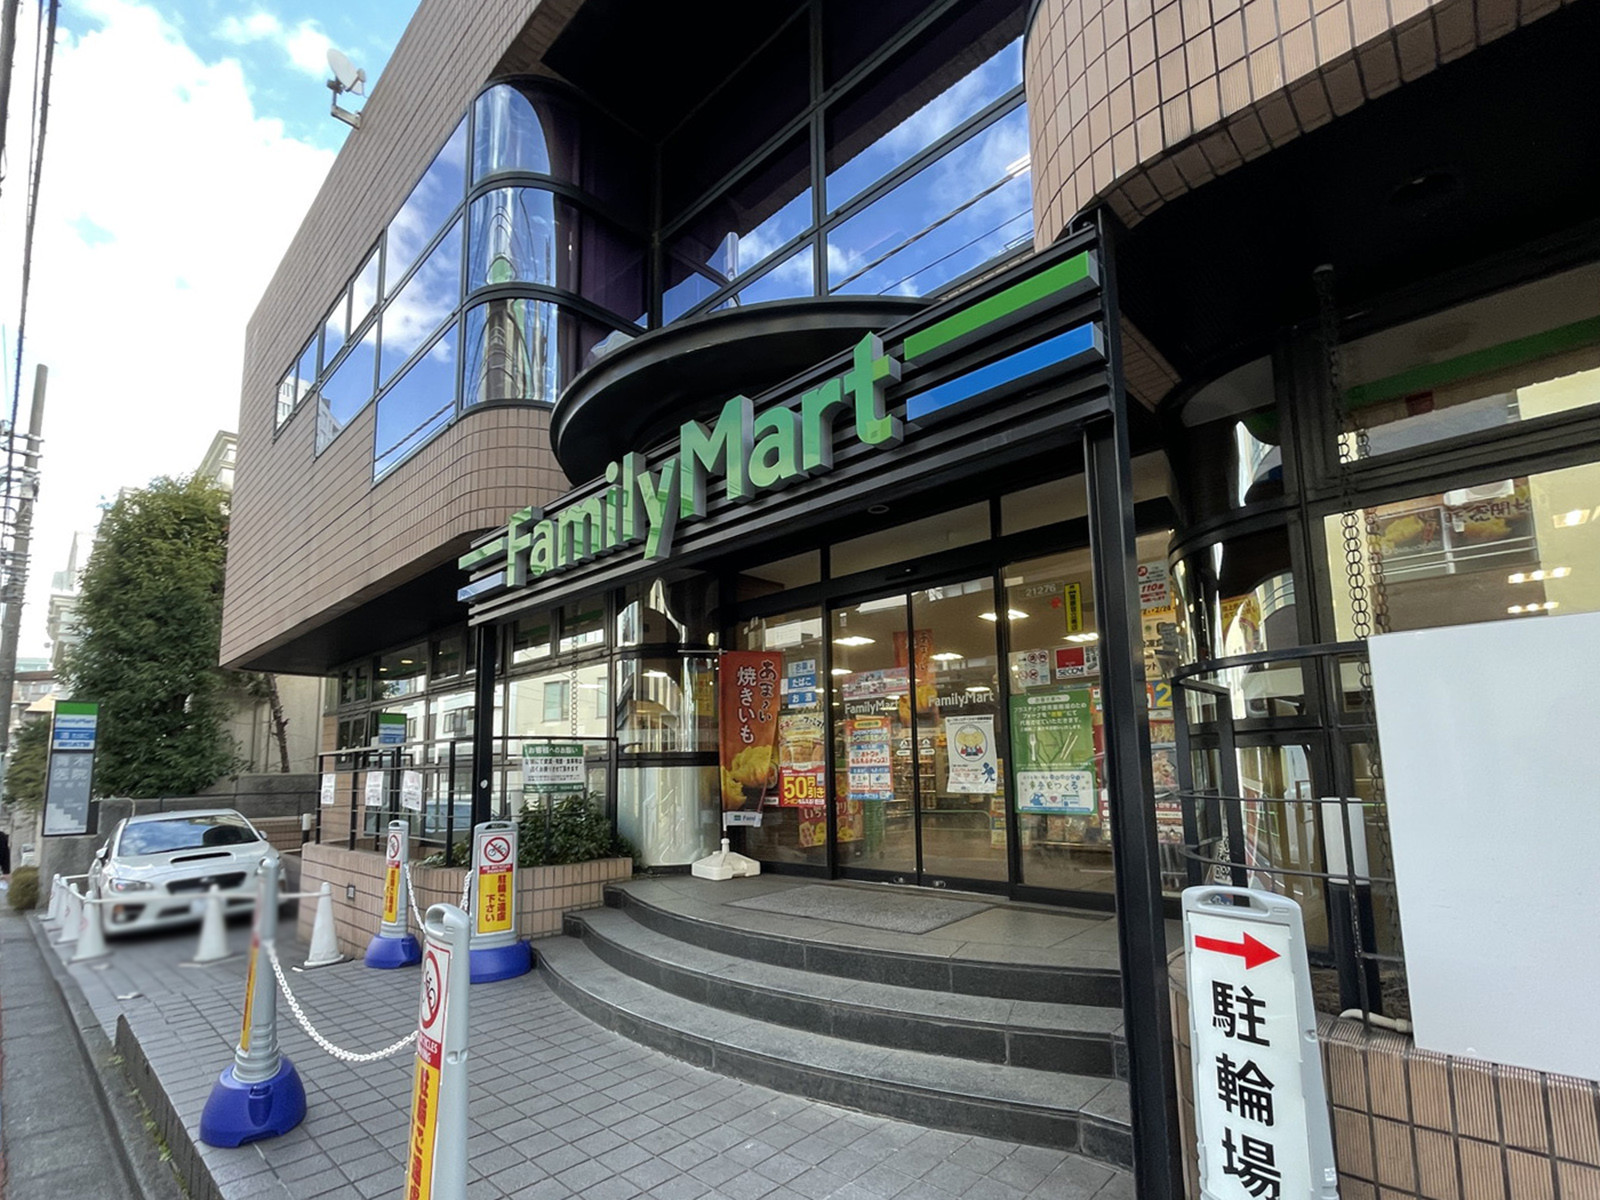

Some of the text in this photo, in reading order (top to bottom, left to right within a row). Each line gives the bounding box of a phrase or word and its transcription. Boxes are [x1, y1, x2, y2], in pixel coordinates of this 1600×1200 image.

[507, 331, 904, 588] FamilyMart
[1025, 583, 1056, 597] 21276
[1057, 667, 1084, 676] SECOM
[792, 677, 812, 688] たばこ
[736, 665, 757, 744] 焼きいも
[844, 699, 899, 715] FamilyMart
[927, 691, 994, 707] FamilyMart
[485, 893, 496, 923] 下さい
[1211, 979, 1282, 1200] 駐輪場
